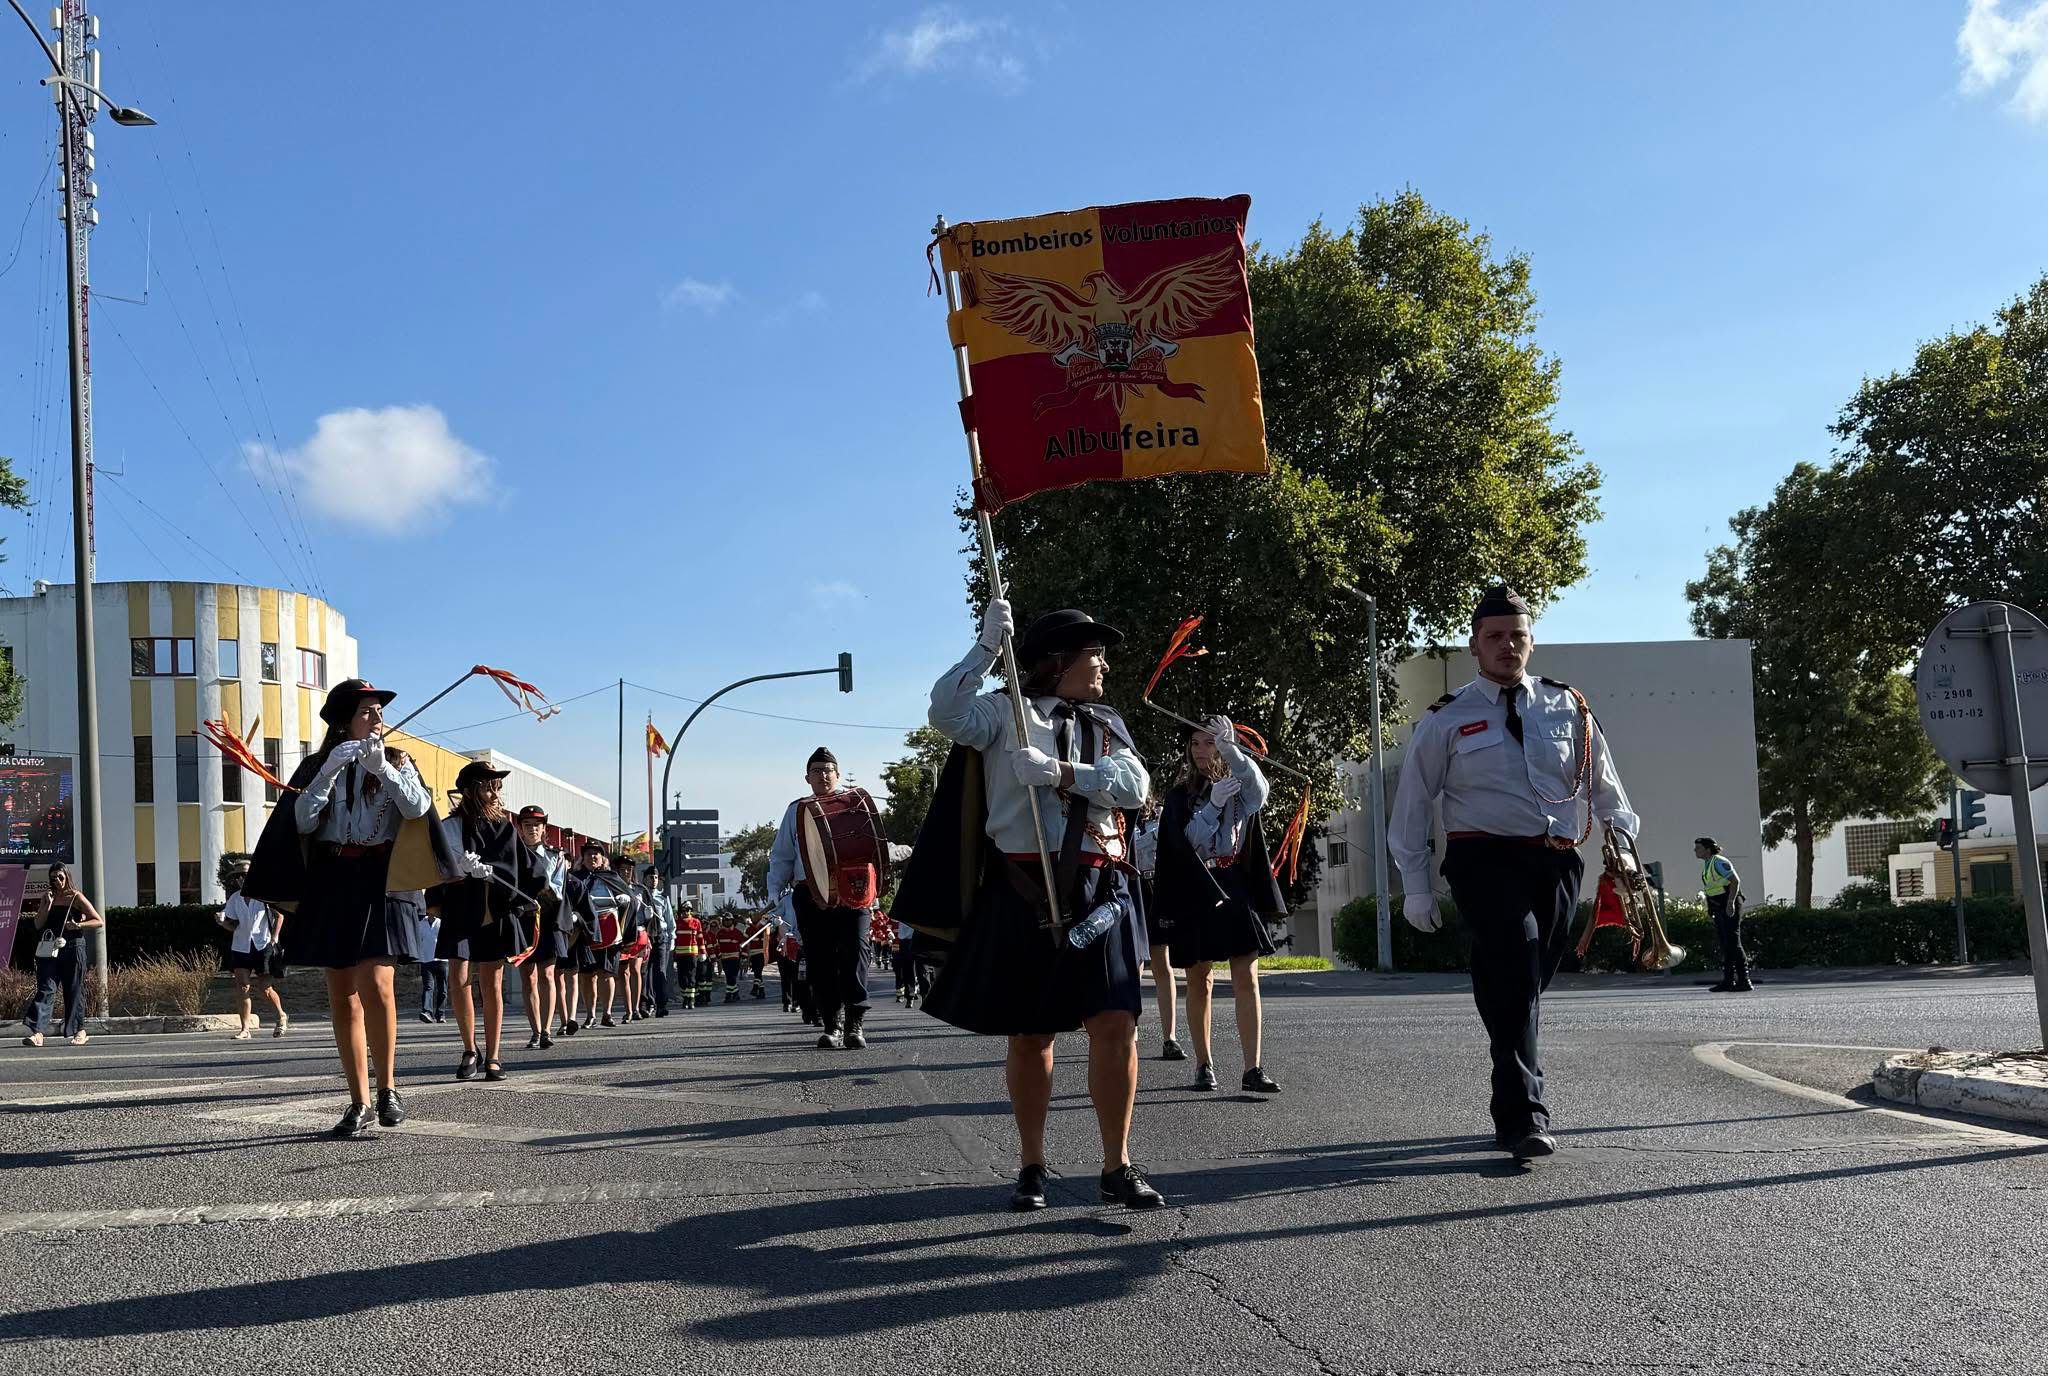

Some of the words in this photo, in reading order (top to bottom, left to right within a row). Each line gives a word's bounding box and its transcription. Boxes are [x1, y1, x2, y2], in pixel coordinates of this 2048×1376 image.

[971, 227, 1093, 258] Bombeiros
[1102, 215, 1238, 243] Voluntários
[1043, 423, 1200, 463] Albufeira
[1930, 708, 1984, 719] 08-07-02
[11, 757, 45, 766] EVENTOS
